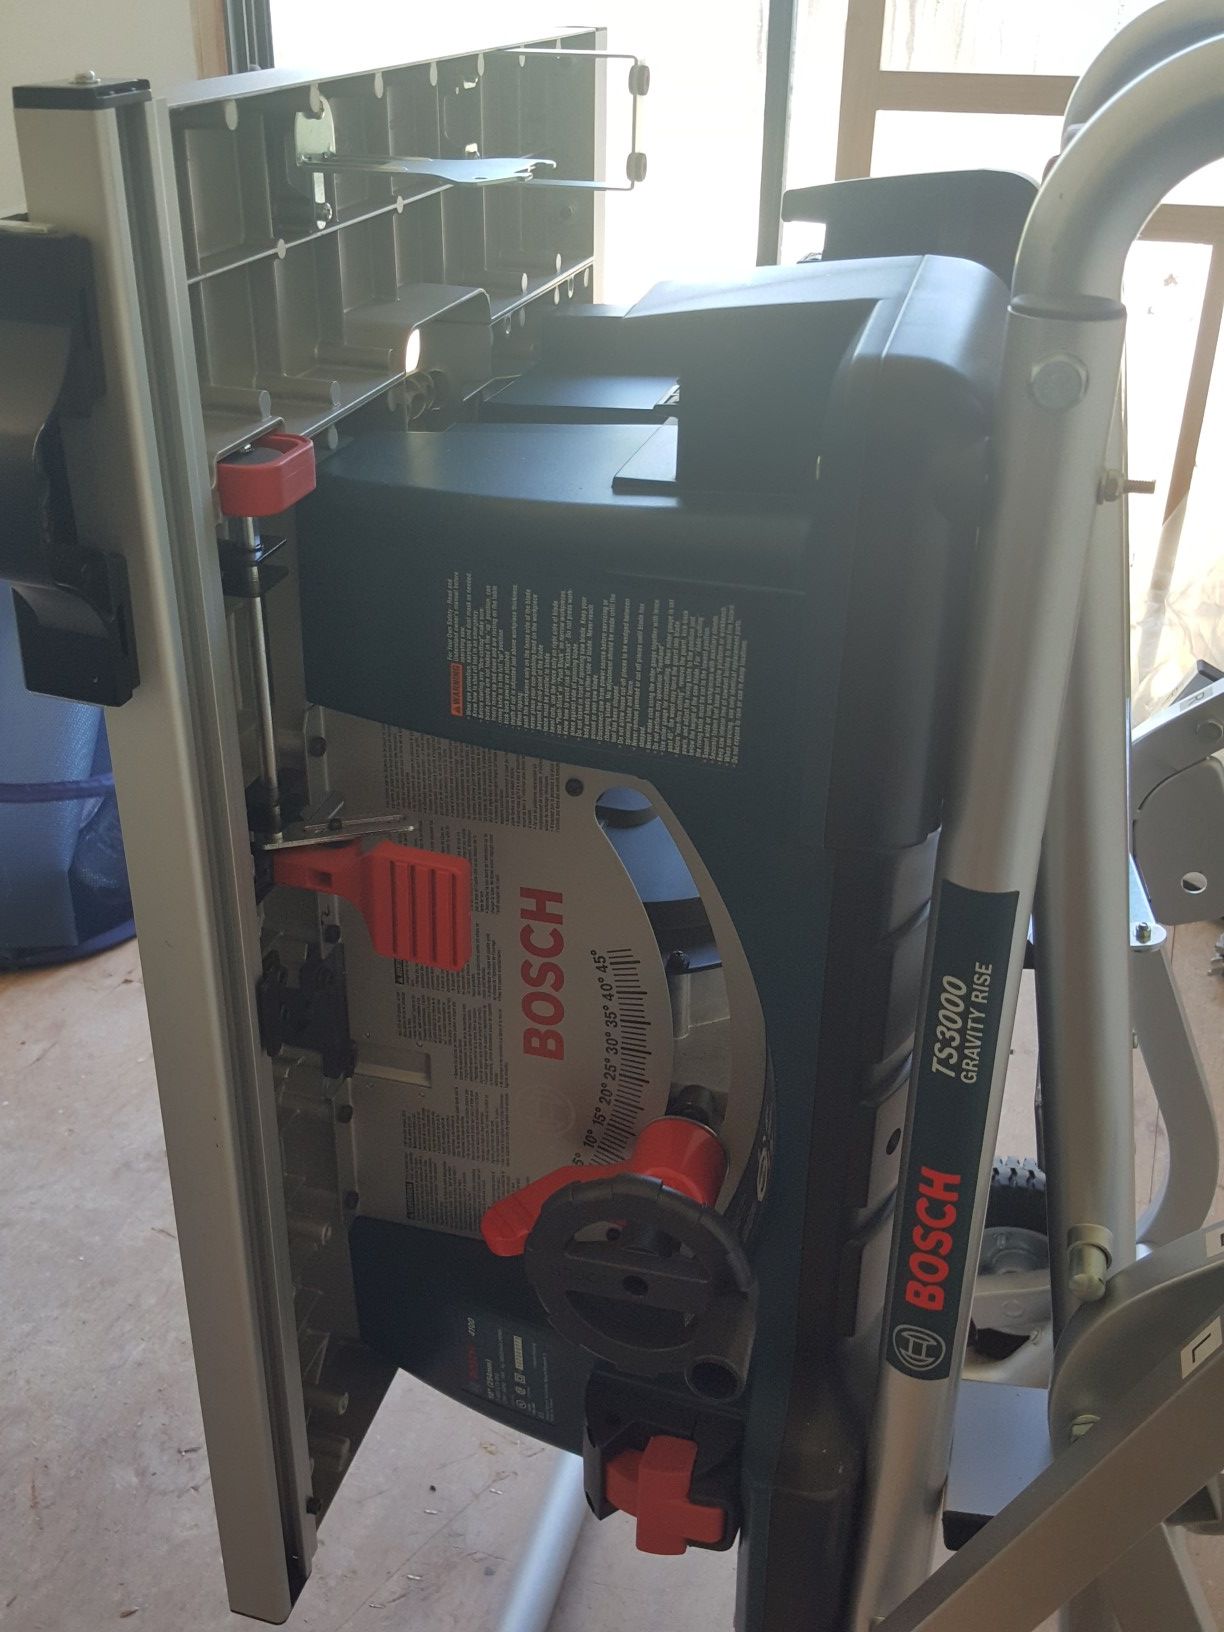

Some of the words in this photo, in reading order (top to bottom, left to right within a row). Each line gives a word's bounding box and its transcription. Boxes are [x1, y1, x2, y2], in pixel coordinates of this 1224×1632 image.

[520, 887, 564, 1060] BOSCH
[591, 950, 607, 973] 45°
[598, 977, 615, 1001] 40°
[972, 961, 993, 1004] RISE
[602, 1005, 617, 1028] 35°
[932, 975, 967, 1078] TS3000
[605, 1032, 619, 1055] 30°
[961, 1007, 986, 1084] GRAVITY
[604, 1058, 617, 1080] 25°
[599, 1082, 613, 1106] 20°
[592, 1106, 606, 1127] 15°
[583, 1129, 597, 1149] 10°
[905, 1166, 961, 1311] BOSCH
